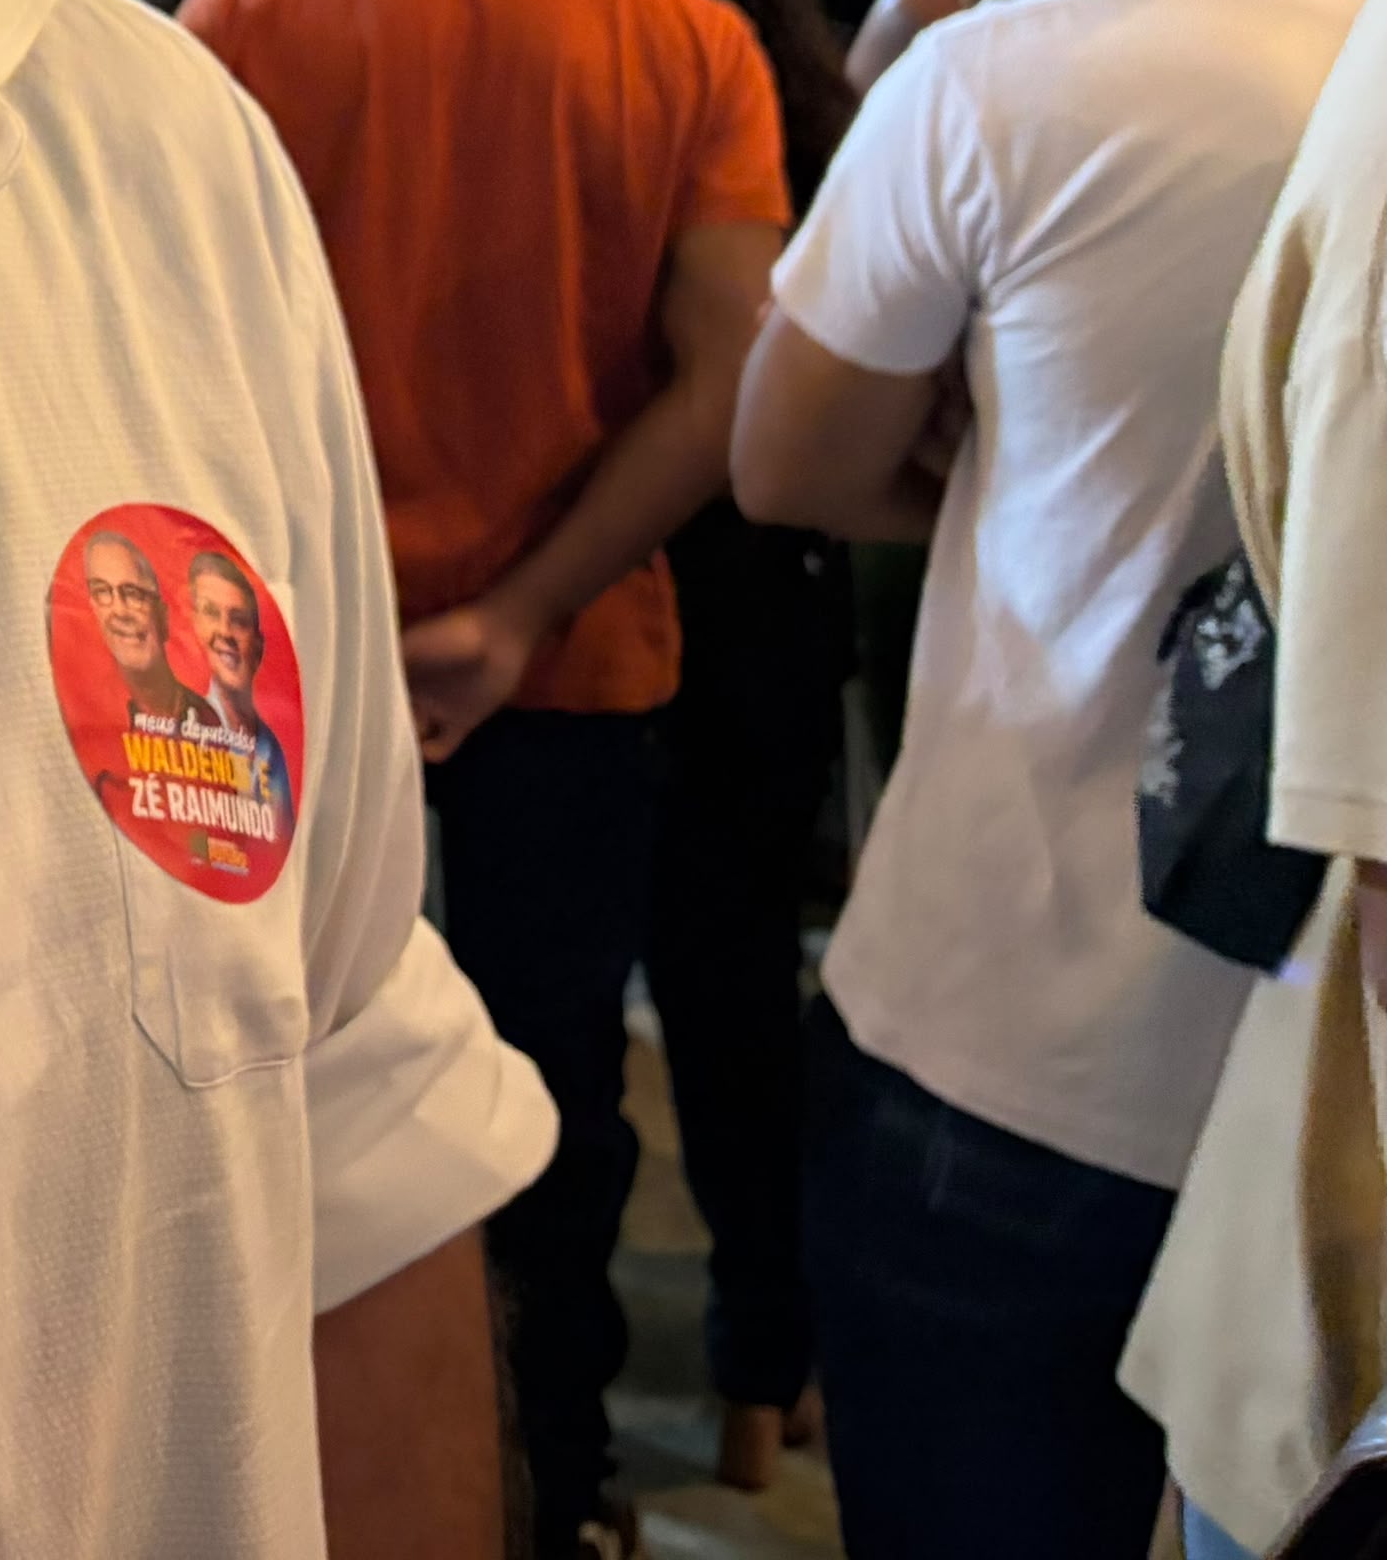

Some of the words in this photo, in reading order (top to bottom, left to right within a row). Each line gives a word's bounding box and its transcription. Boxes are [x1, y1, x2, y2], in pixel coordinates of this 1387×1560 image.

[133, 712, 176, 735] meus
[128, 773, 165, 819] ZÉ
[166, 781, 275, 842] RAIMUNDO
